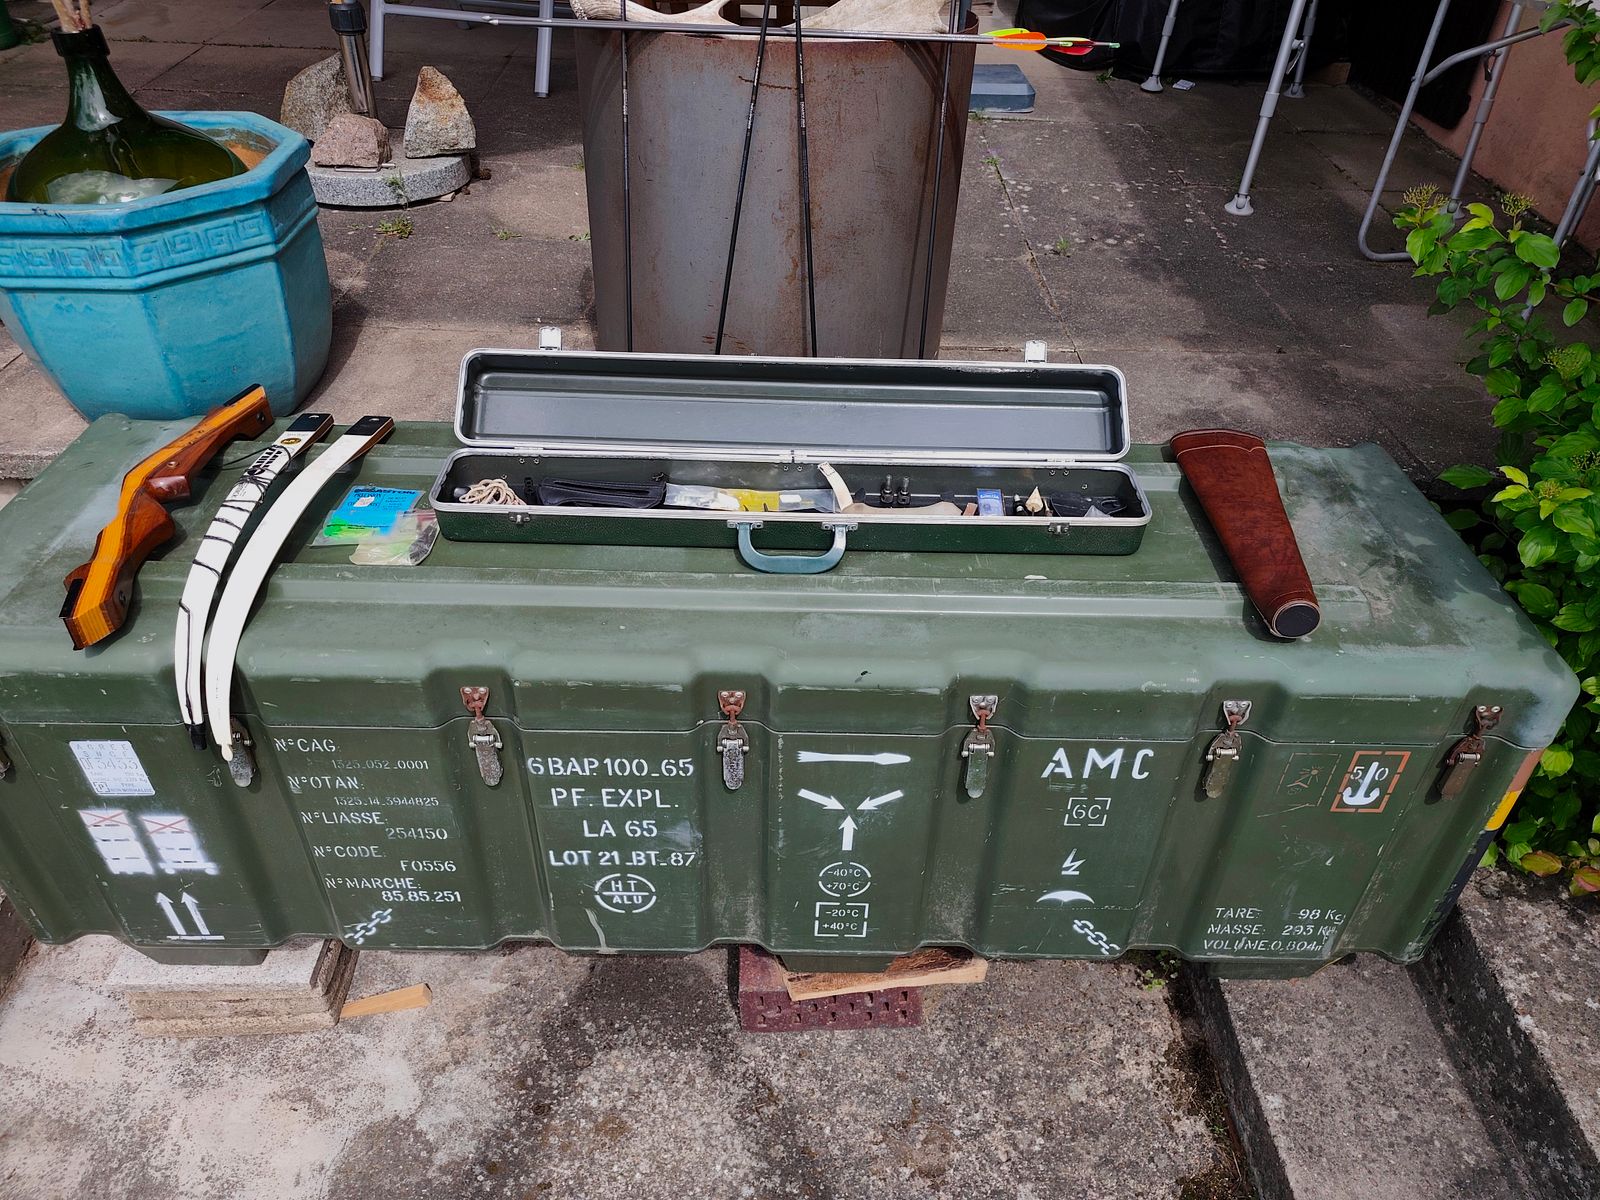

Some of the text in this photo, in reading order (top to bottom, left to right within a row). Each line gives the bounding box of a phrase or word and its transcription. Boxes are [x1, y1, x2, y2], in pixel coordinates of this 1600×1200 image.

[1040, 747, 1155, 780] AMC
[601, 788, 680, 808] EXPL.
[385, 827, 448, 840] 254150
[582, 819, 658, 838] LA 65
[549, 850, 592, 866] LOT
[381, 890, 462, 903] 85.85.251
[612, 895, 643, 904] ALU
[1298, 908, 1321, 920] 98
